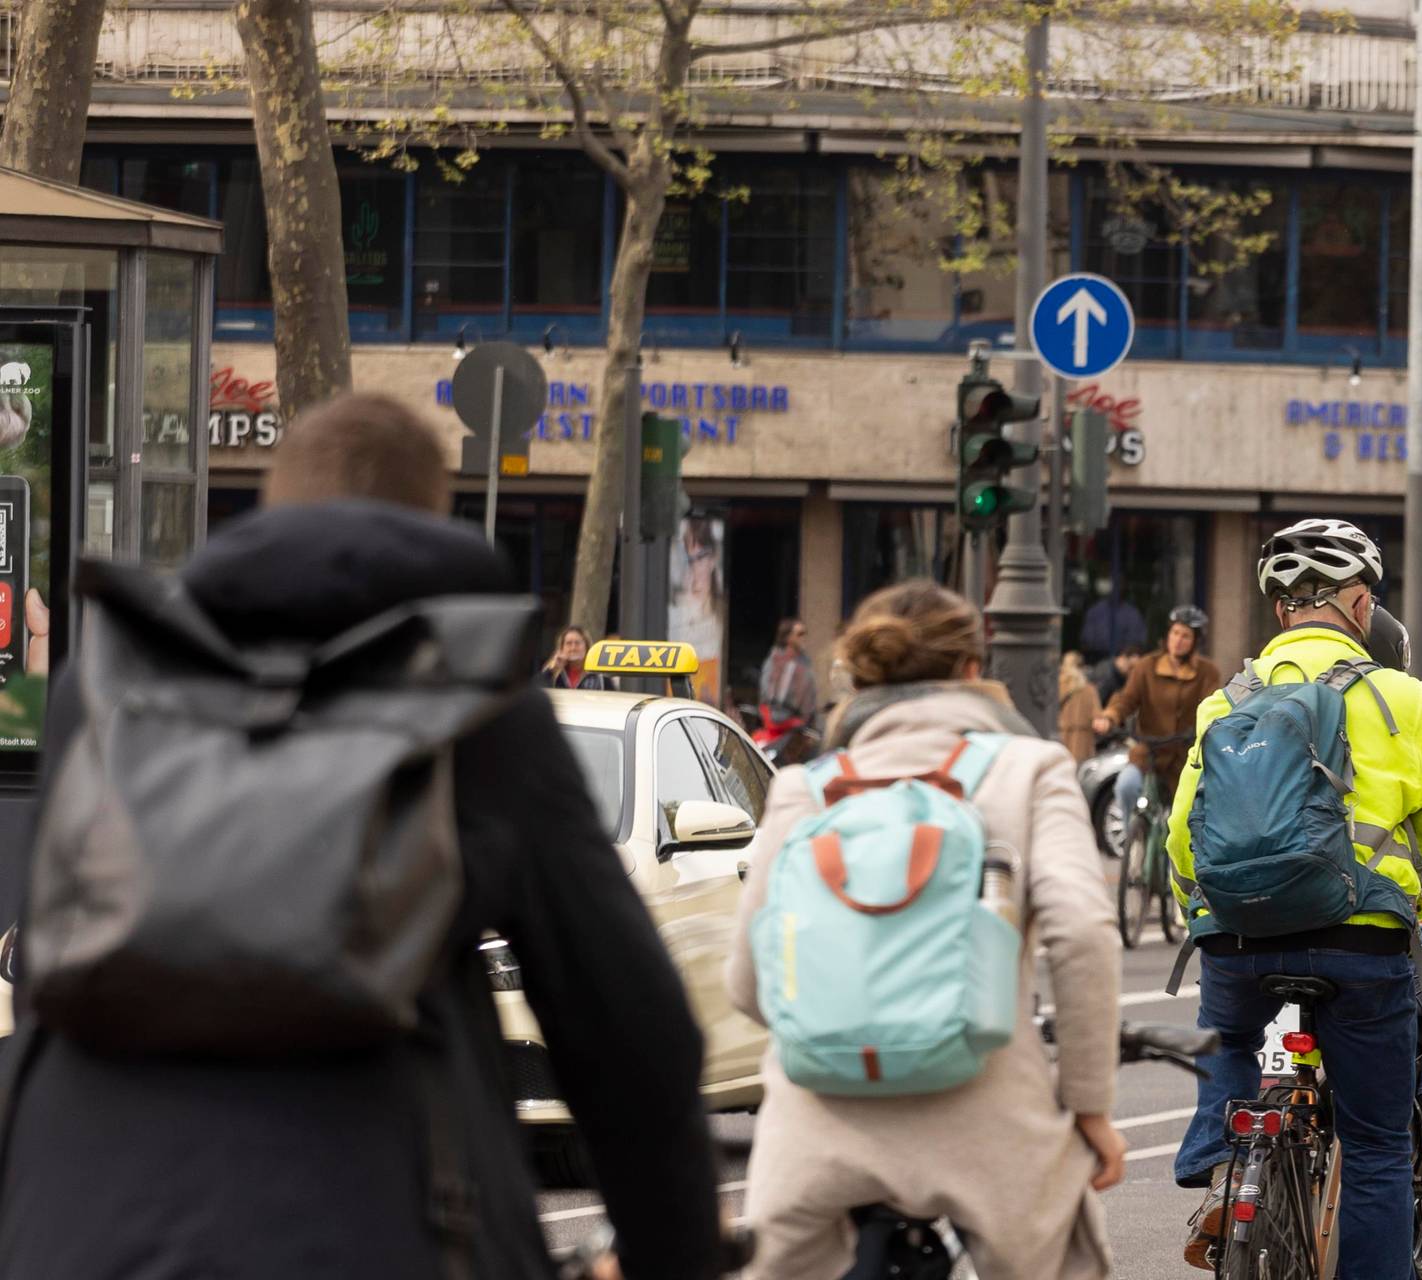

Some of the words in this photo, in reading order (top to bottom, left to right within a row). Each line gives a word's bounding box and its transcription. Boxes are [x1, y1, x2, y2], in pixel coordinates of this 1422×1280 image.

[1285, 399, 1408, 429] AMERICA
[604, 645, 676, 667] TAXI
[0, 737, 19, 746] Stadt
[20, 736, 37, 746] Köln
